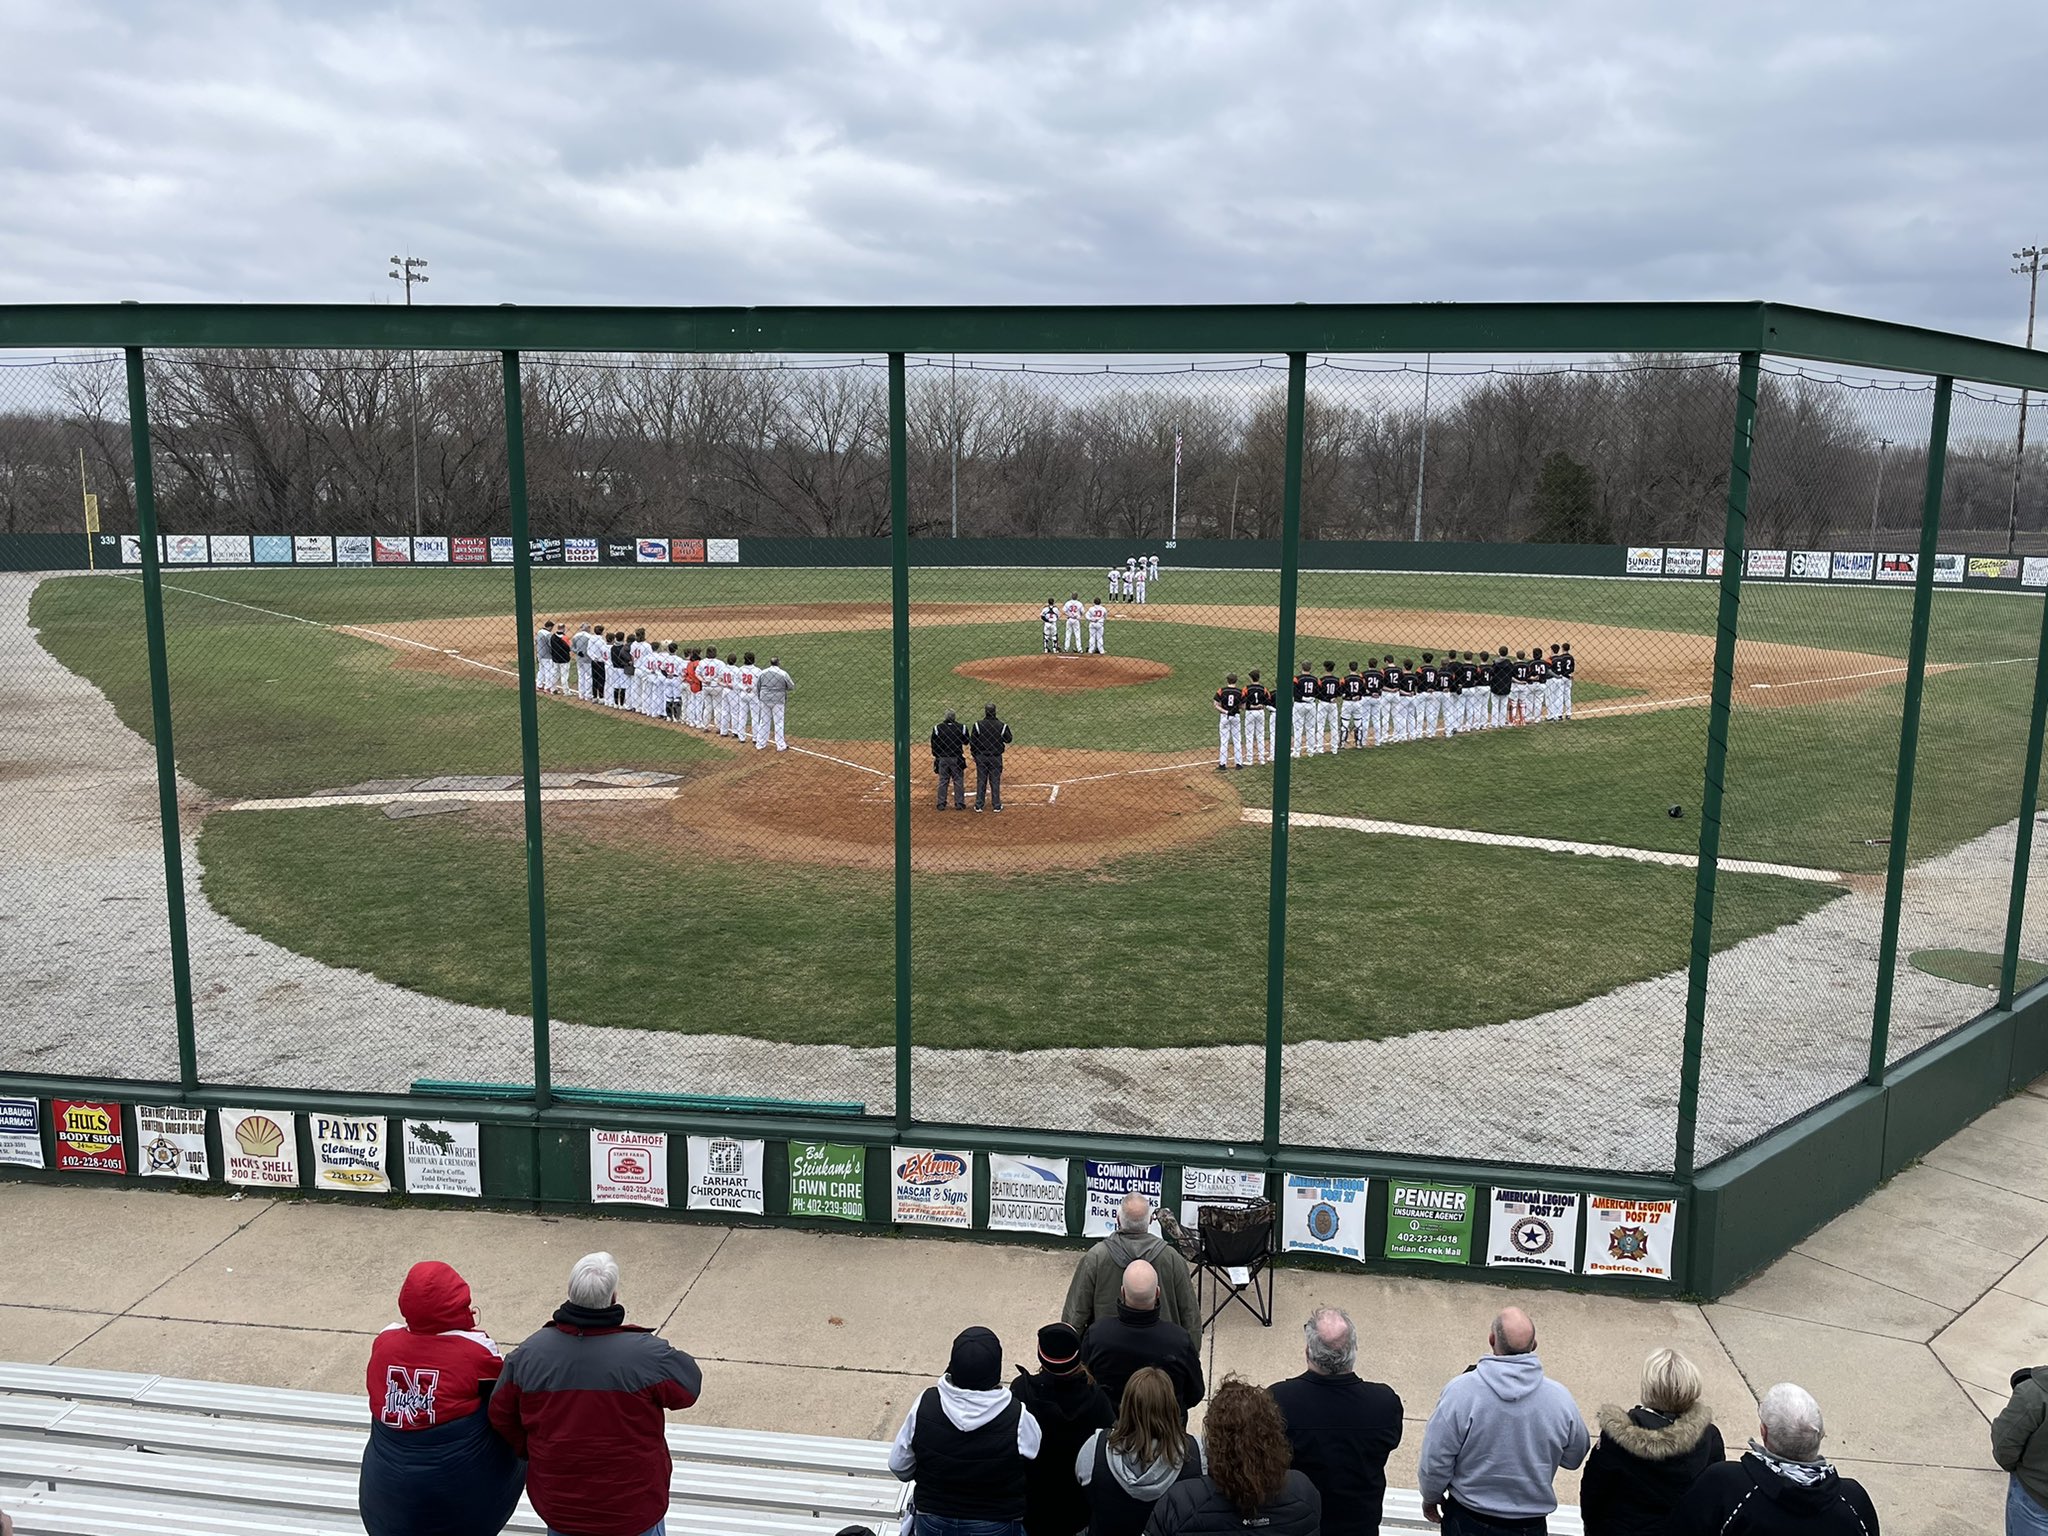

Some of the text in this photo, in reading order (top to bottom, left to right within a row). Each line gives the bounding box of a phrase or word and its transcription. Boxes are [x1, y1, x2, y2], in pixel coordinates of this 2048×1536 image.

[100, 536, 116, 545] 330
[571, 539, 596, 547] RON'S
[1628, 558, 1660, 566] SUNRISE
[1368, 677, 1379, 689] 24
[1389, 672, 1399, 684] 12
[1303, 681, 1314, 694] 19
[1349, 681, 1359, 693] 13
[166, 1108, 188, 1121] POLICE
[0, 1116, 34, 1127] HARMACY
[69, 1113, 108, 1130] HULS
[182, 1123, 188, 1135] OF
[317, 1119, 377, 1142] PAM'S
[59, 1131, 122, 1144] BODY SHOP
[597, 1132, 663, 1145] CAMI SAATHOFF
[184, 1151, 205, 1163] LODGE
[322, 1143, 378, 1159] Cleaning &
[805, 1146, 825, 1160] Bob
[62, 1156, 122, 1170] 402-228-2051
[230, 1158, 293, 1172] NICK'S SHELL
[322, 1154, 380, 1171] Shampooing
[792, 1154, 861, 1180] Steinkamp's
[231, 1169, 294, 1183] 900 E. COURT
[331, 1171, 375, 1182] 228-1522
[422, 1167, 445, 1176] Zachary
[1097, 1163, 1151, 1179] COMMUNITY
[703, 1175, 749, 1187] EARHART
[1087, 1176, 1161, 1194] MEDICAL CENTER
[1198, 1172, 1236, 1185] DEINES
[1288, 1175, 1364, 1192] AMERICAN LEGION
[597, 1184, 616, 1192] Phone
[690, 1185, 762, 1200] CHIROPRACTIC
[792, 1178, 862, 1199] LAWN CARE
[992, 1181, 1065, 1201] BEATRICE ORTHOPAEDICS
[1198, 1183, 1235, 1192] PHARMACY
[896, 1185, 968, 1206] NASCAR & Signs
[1090, 1193, 1102, 1204] Dr.
[1320, 1188, 1356, 1203] POST 27
[1393, 1188, 1467, 1210] PENNER
[1495, 1190, 1575, 1207] AMERICAN LEGION
[709, 1197, 742, 1208] CLINIC
[792, 1198, 863, 1216] PH: 402-239-8000
[1591, 1197, 1671, 1213] AMERICAN LEGION
[931, 1209, 967, 1217] BASEBALL
[992, 1203, 1064, 1223] AND SPORTS MEDICINE
[1091, 1206, 1110, 1218] Rick
[1394, 1208, 1463, 1221] INSURANCE AGENCY
[1529, 1204, 1565, 1218] POST 27
[1625, 1211, 1661, 1224] POST 27
[1397, 1233, 1458, 1244] 402-223-4018
[1391, 1244, 1462, 1256] Indian Creek Mall
[1494, 1255, 1567, 1267] Beatrice, NE
[1590, 1263, 1663, 1274] Beatrice, NE
[381, 1365, 439, 1428] N
